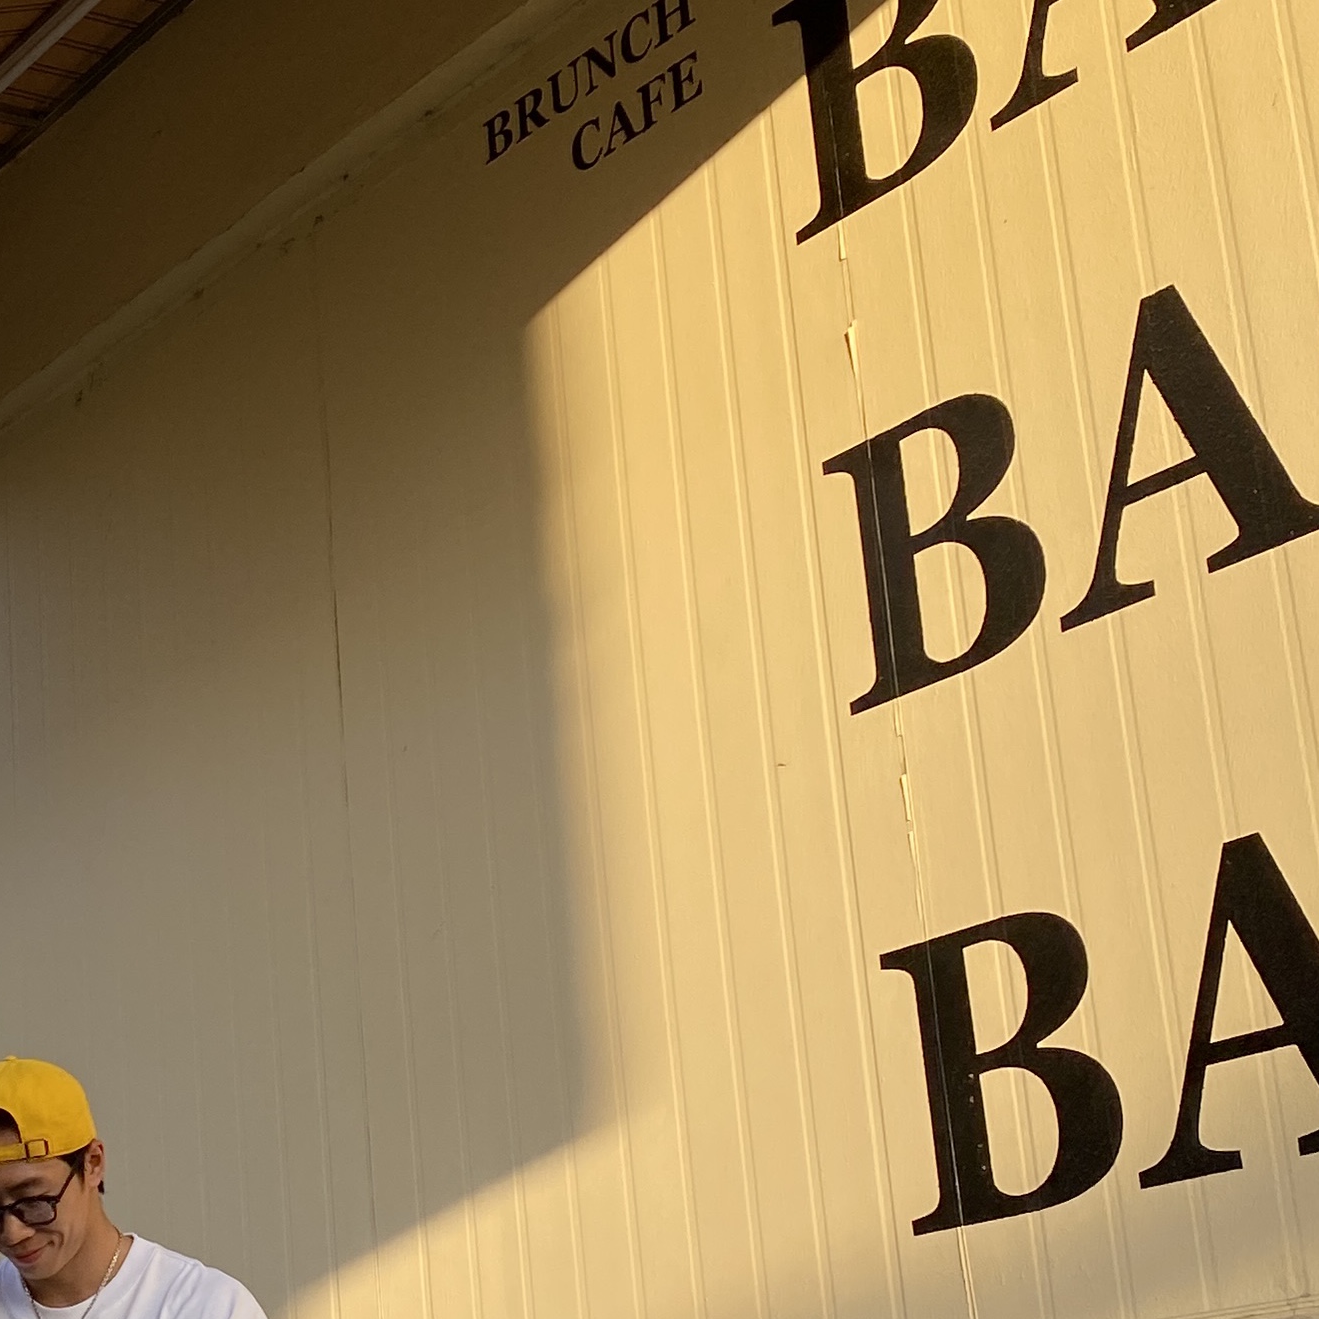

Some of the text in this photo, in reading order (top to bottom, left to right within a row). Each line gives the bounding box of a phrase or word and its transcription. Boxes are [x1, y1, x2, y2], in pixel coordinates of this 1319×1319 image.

[483, 0, 697, 166] BRUNCH
[571, 50, 703, 171] CAFE
[823, 285, 1319, 716] BA
[880, 832, 1319, 1237] BA
